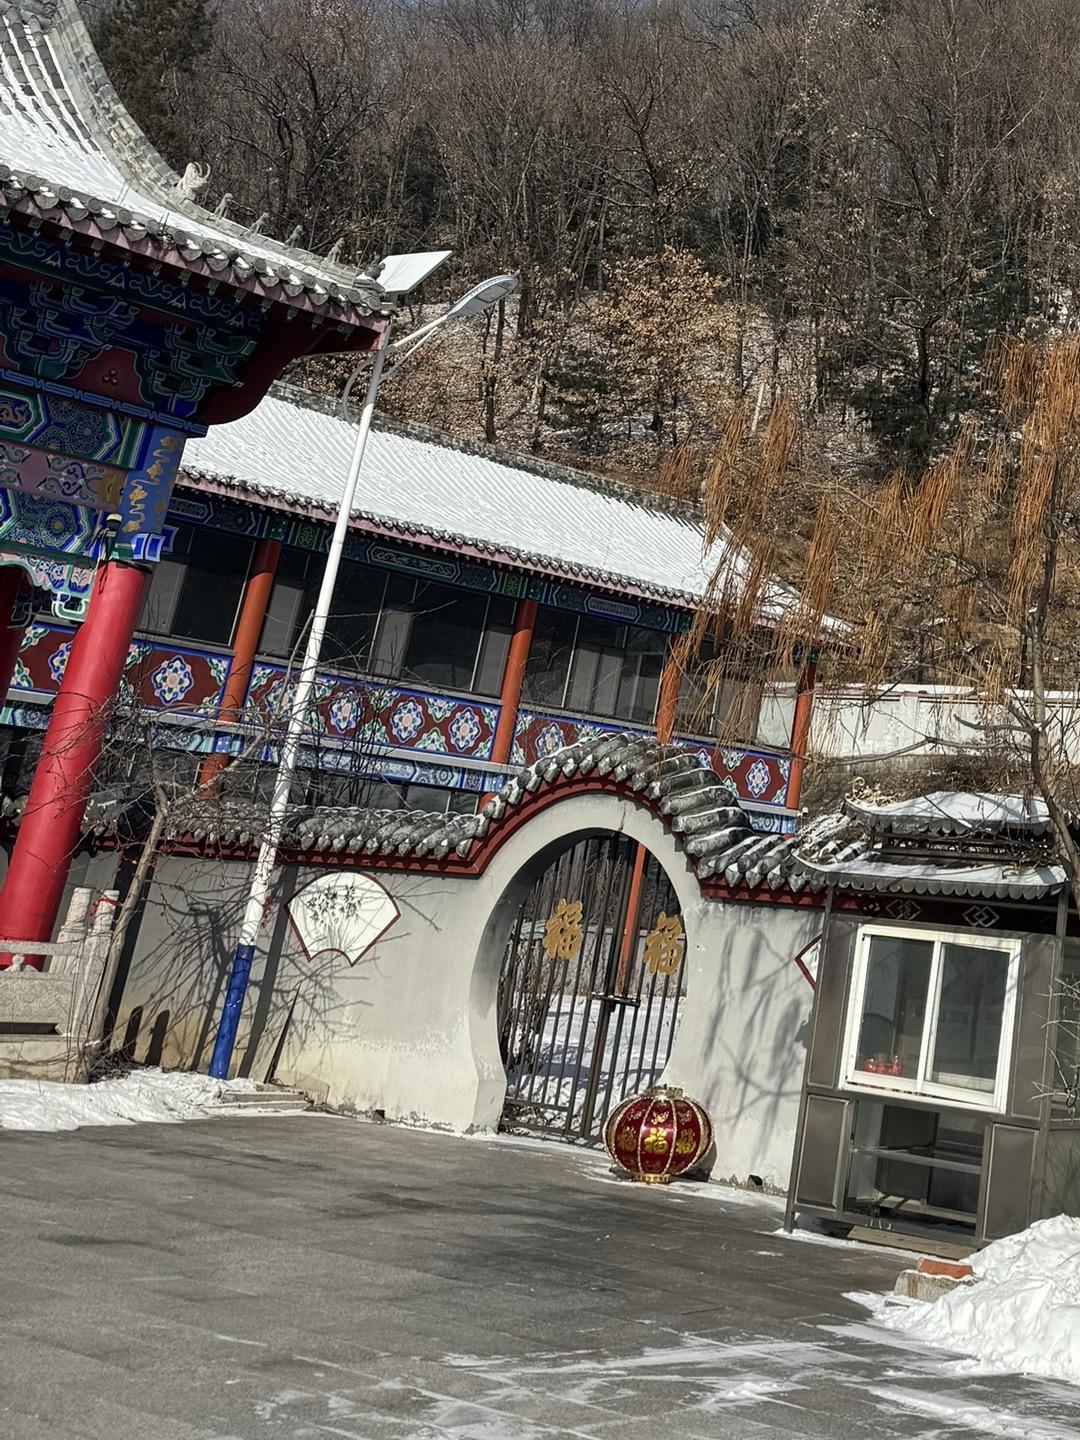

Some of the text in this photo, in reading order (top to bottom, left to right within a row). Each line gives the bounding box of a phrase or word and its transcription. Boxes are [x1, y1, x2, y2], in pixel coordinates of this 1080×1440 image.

[543, 898, 583, 960] 福
[643, 911, 683, 975] 福
[644, 1127, 669, 1154] 福
